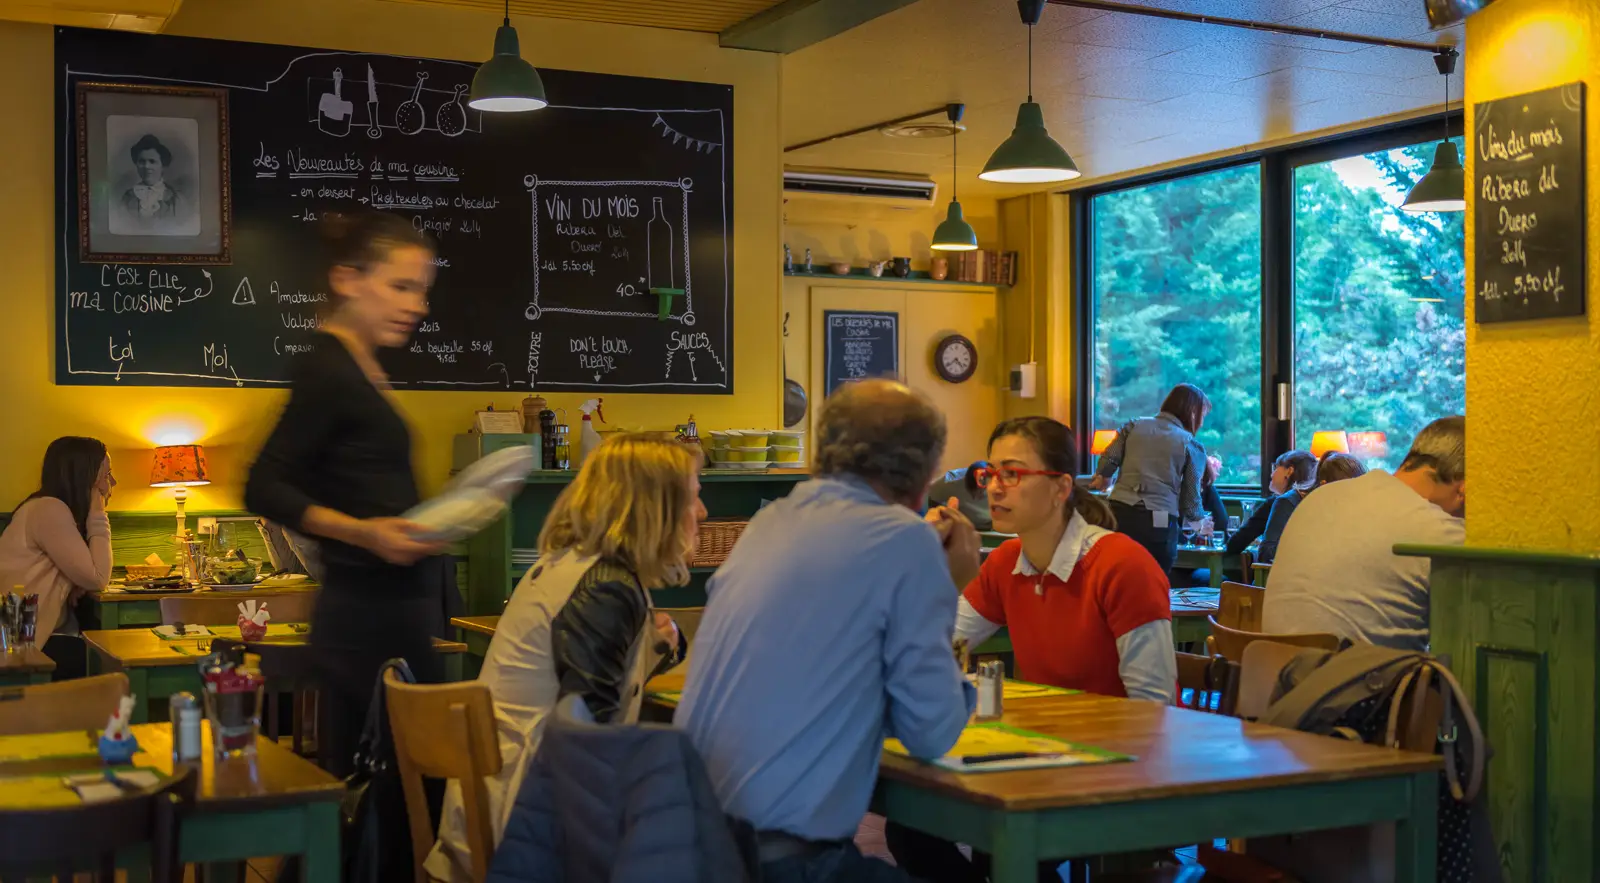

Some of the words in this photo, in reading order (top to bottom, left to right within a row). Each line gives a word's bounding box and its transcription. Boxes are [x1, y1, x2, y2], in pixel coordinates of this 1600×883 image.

[1529, 118, 1562, 147] mois
[253, 141, 280, 171] Les
[287, 148, 364, 173] Nouveautés
[370, 155, 384, 172] de
[388, 161, 409, 173] ma
[300, 187, 315, 198] en
[317, 184, 356, 199] dessert
[435, 195, 449, 206] au
[454, 193, 500, 209] chocolat
[1481, 173, 1530, 202] Ribera
[582, 197, 601, 219] DU
[1496, 205, 1538, 235] Duero
[556, 222, 597, 236] Ribera
[70, 291, 105, 312] ma
[419, 321, 441, 333] 2013
[109, 330, 134, 362] toi
[203, 343, 228, 372] Moi
[427, 339, 464, 354] bouteille
[470, 340, 482, 352] 55
